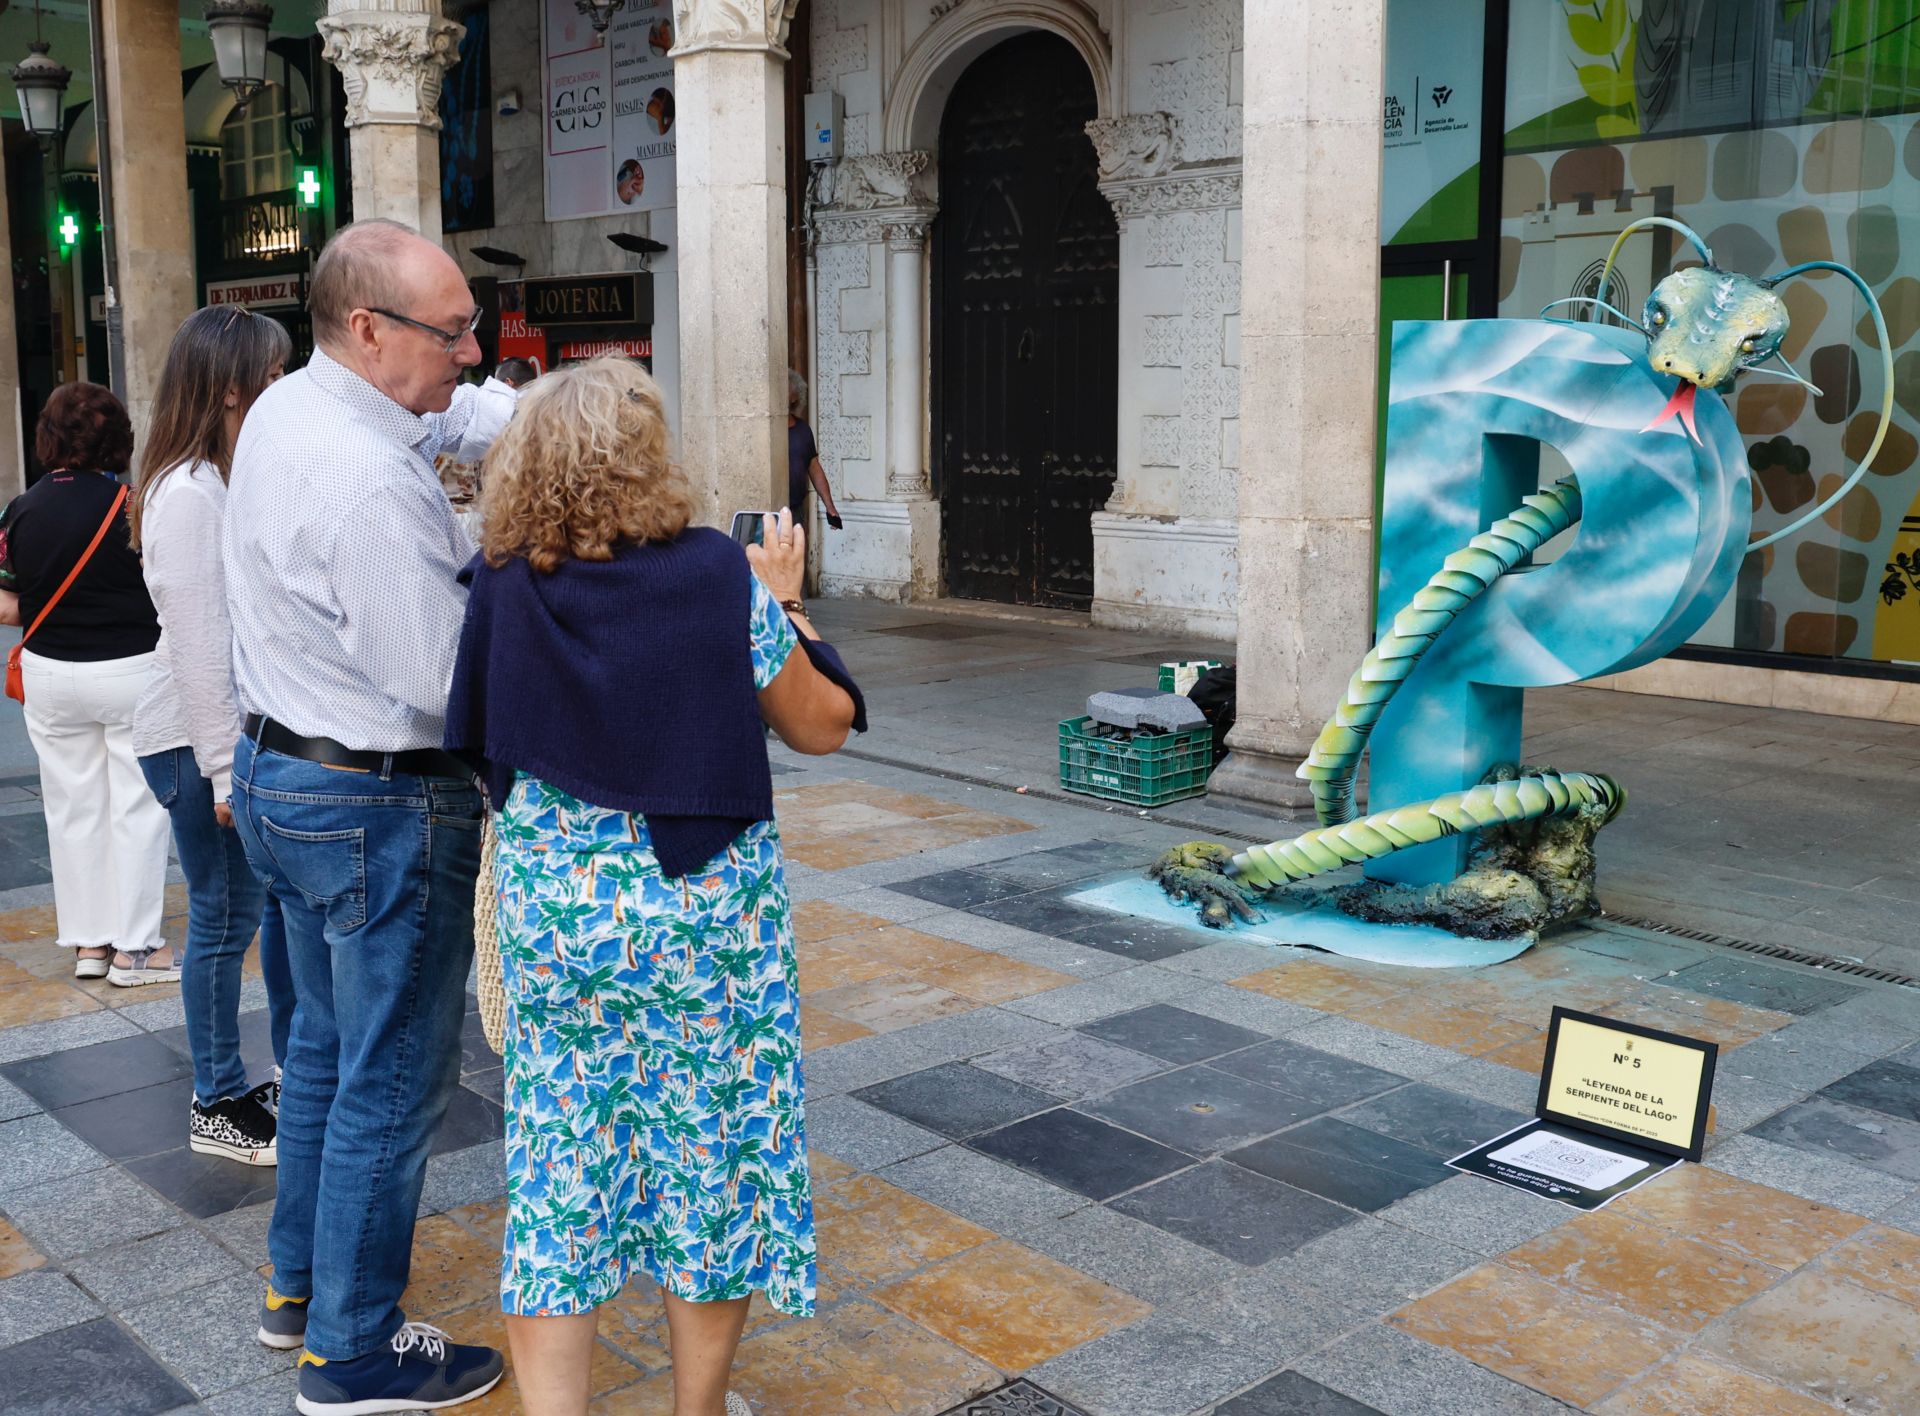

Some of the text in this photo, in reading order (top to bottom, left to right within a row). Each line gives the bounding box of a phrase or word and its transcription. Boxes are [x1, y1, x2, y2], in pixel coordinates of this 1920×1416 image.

[614, 58, 636, 68] CARBON
[614, 78, 630, 88] LASER
[615, 98, 644, 113] MASAJES
[1384, 96, 1398, 107] PA
[551, 101, 606, 118] CARMEN SALGADO
[1384, 106, 1405, 118] LEN
[1384, 118, 1403, 129] CIA
[1424, 122, 1469, 134] Desarrollo Local
[1425, 117, 1446, 126] Agencia
[636, 140, 676, 157] MANICURAS
[210, 289, 224, 305] DE
[226, 282, 287, 304] FERNANDEZ
[535, 286, 623, 314] JOYERIA
[1632, 1058, 1641, 1069] 5
[1566, 1087, 1620, 1108] SERPIENTE
[1622, 1102, 1642, 1114] DEL
[1634, 1091, 1648, 1102] DE
[1650, 1095, 1664, 1106] LA
[1497, 1170, 1529, 1183] votarme
[1517, 1172, 1550, 1184] gustado
[1549, 1182, 1581, 1194] puedes
